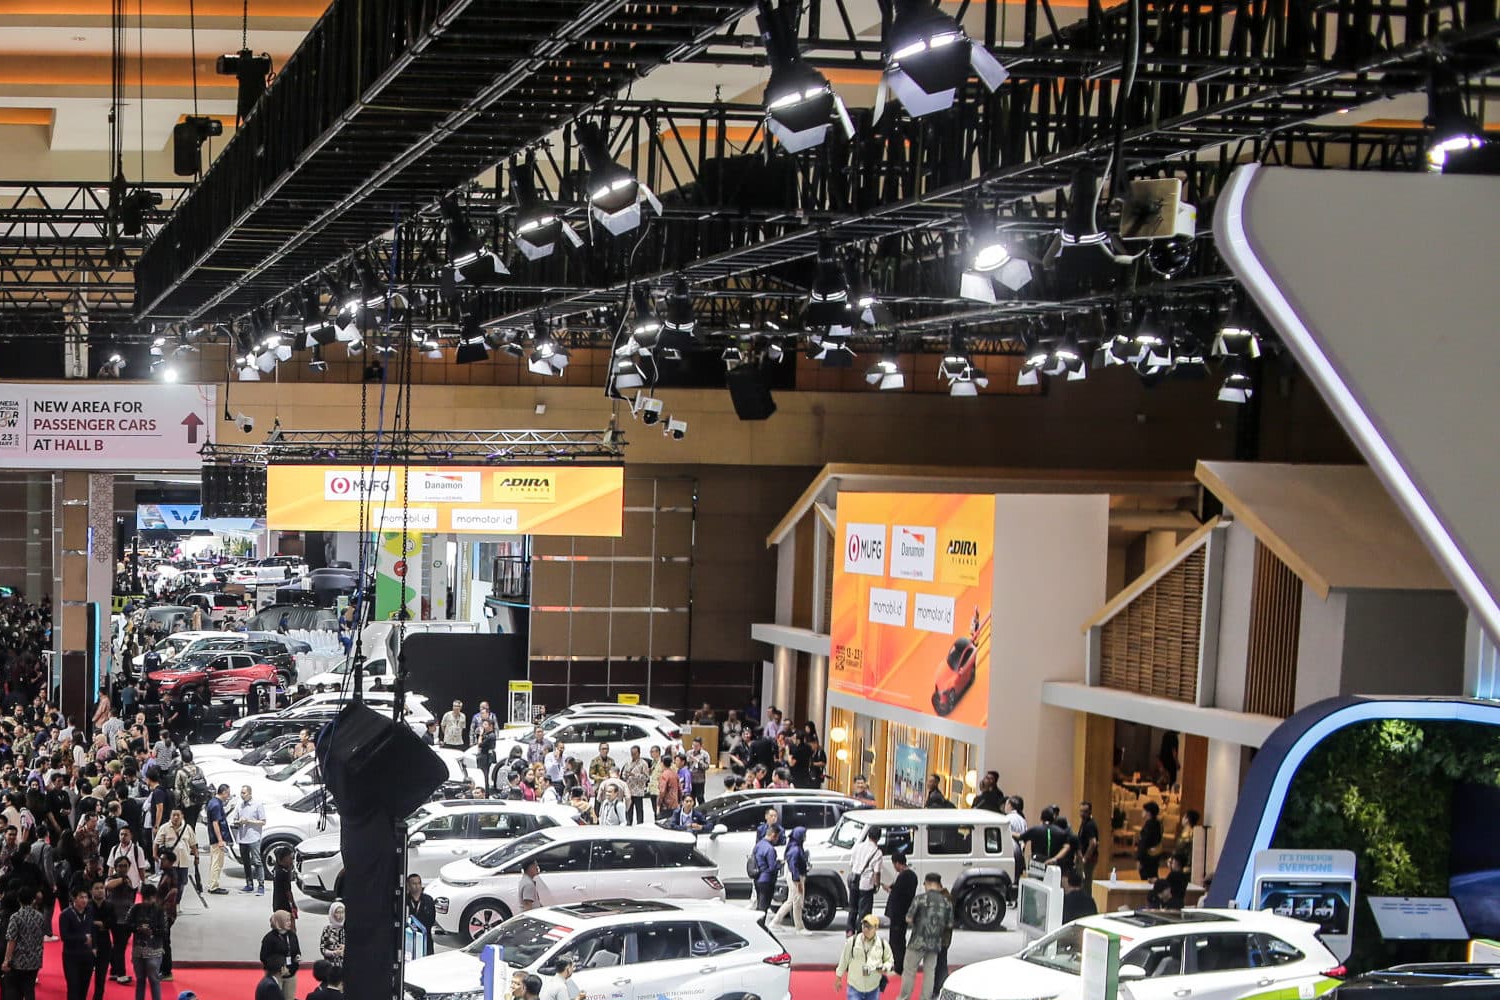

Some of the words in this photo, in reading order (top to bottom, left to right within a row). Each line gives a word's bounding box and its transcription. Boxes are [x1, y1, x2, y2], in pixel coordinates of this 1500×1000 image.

[34, 401, 68, 412] NEW
[72, 401, 110, 412] AREA
[114, 402, 142, 413] FOR
[34, 419, 115, 430] PASSENGER
[119, 419, 156, 430] CARS
[34, 439, 52, 451] AT
[54, 440, 91, 451] HALL
[95, 440, 104, 451] B
[353, 480, 390, 492] MUFG
[425, 481, 463, 489] Danamon
[500, 478, 550, 487] ADIRA
[382, 515, 430, 523] mombil.id
[457, 515, 512, 524] momotor.id
[861, 540, 882, 559] MUFG
[901, 542, 925, 557] Danamon
[947, 540, 977, 556] ADIRA
[1278, 863, 1332, 872] EVERYONE
